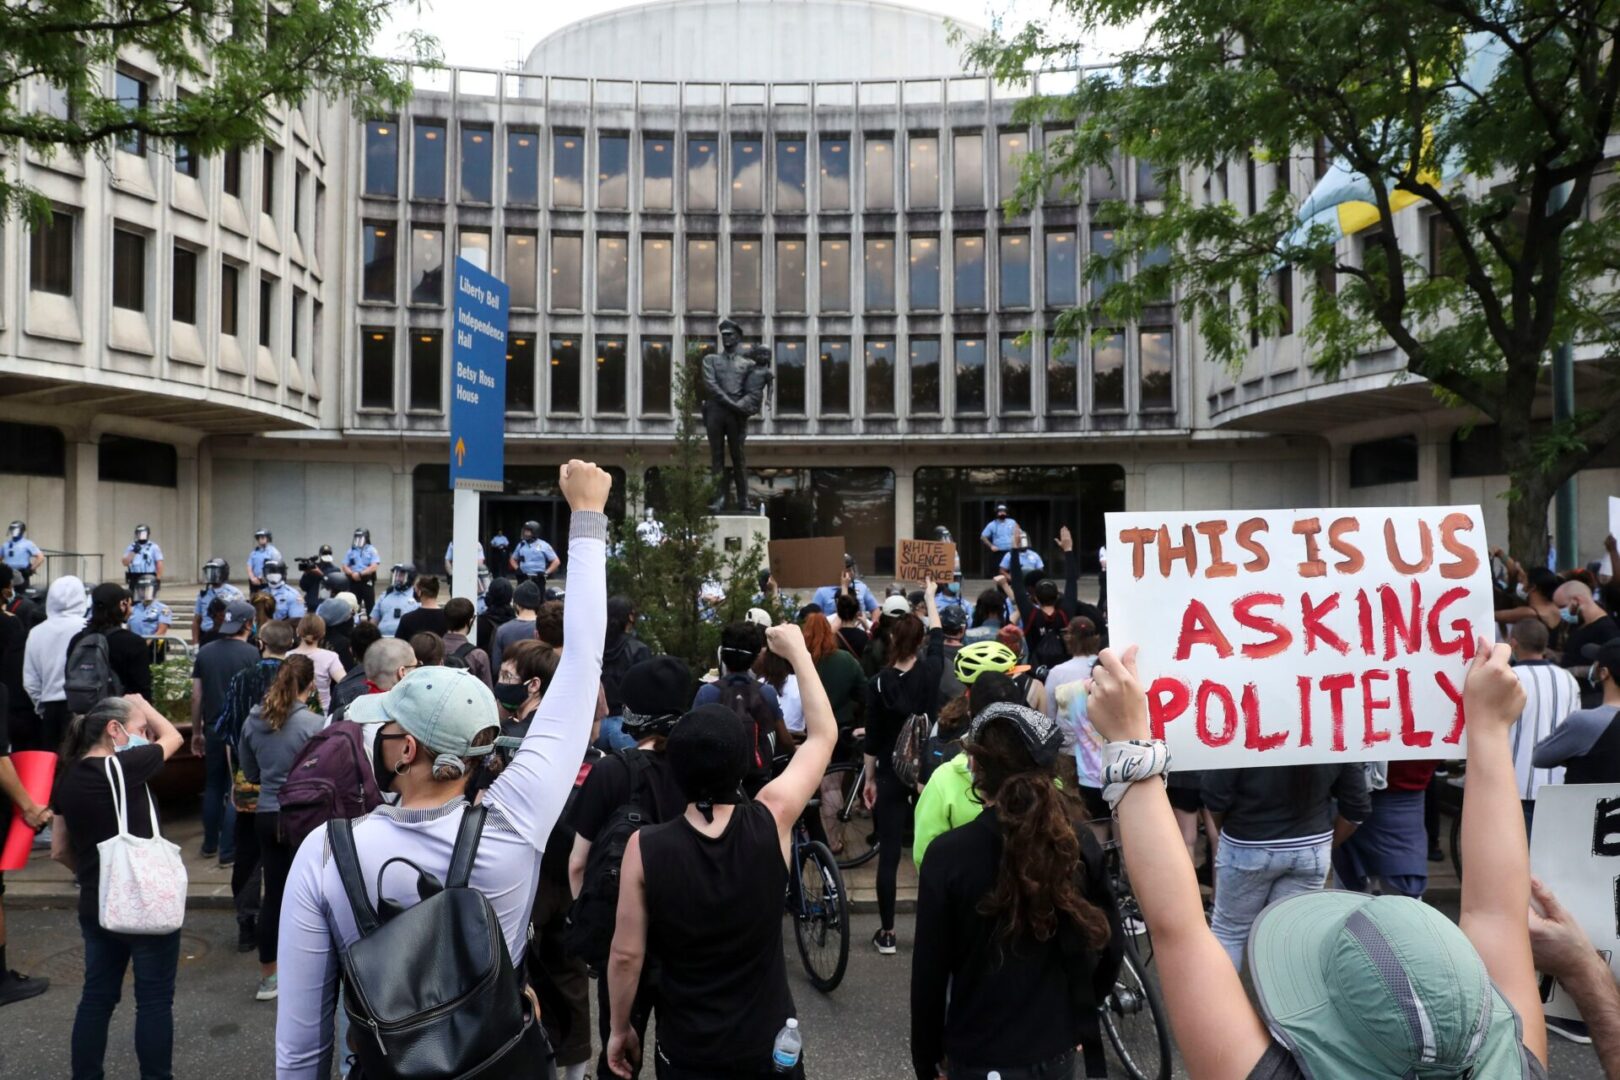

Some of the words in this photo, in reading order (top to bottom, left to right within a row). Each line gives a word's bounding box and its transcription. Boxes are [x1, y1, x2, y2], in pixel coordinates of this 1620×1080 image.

[460, 275, 484, 304] Liberty
[486, 289, 500, 309] Bell
[459, 307, 505, 342] Independence
[458, 329, 472, 349] Hall
[457, 362, 477, 384] Betsy
[479, 369, 495, 388] Ross
[457, 384, 479, 404] House
[901, 552, 947, 566] SILENCE
[903, 542, 944, 554] WHITE
[1119, 517, 1270, 580] THIS
[1291, 516, 1365, 578] IS
[1383, 512, 1480, 580] US
[900, 566, 953, 581] VIOLENCE
[1173, 578, 1476, 665] ASKING
[1145, 667, 1466, 752] POLITELY
